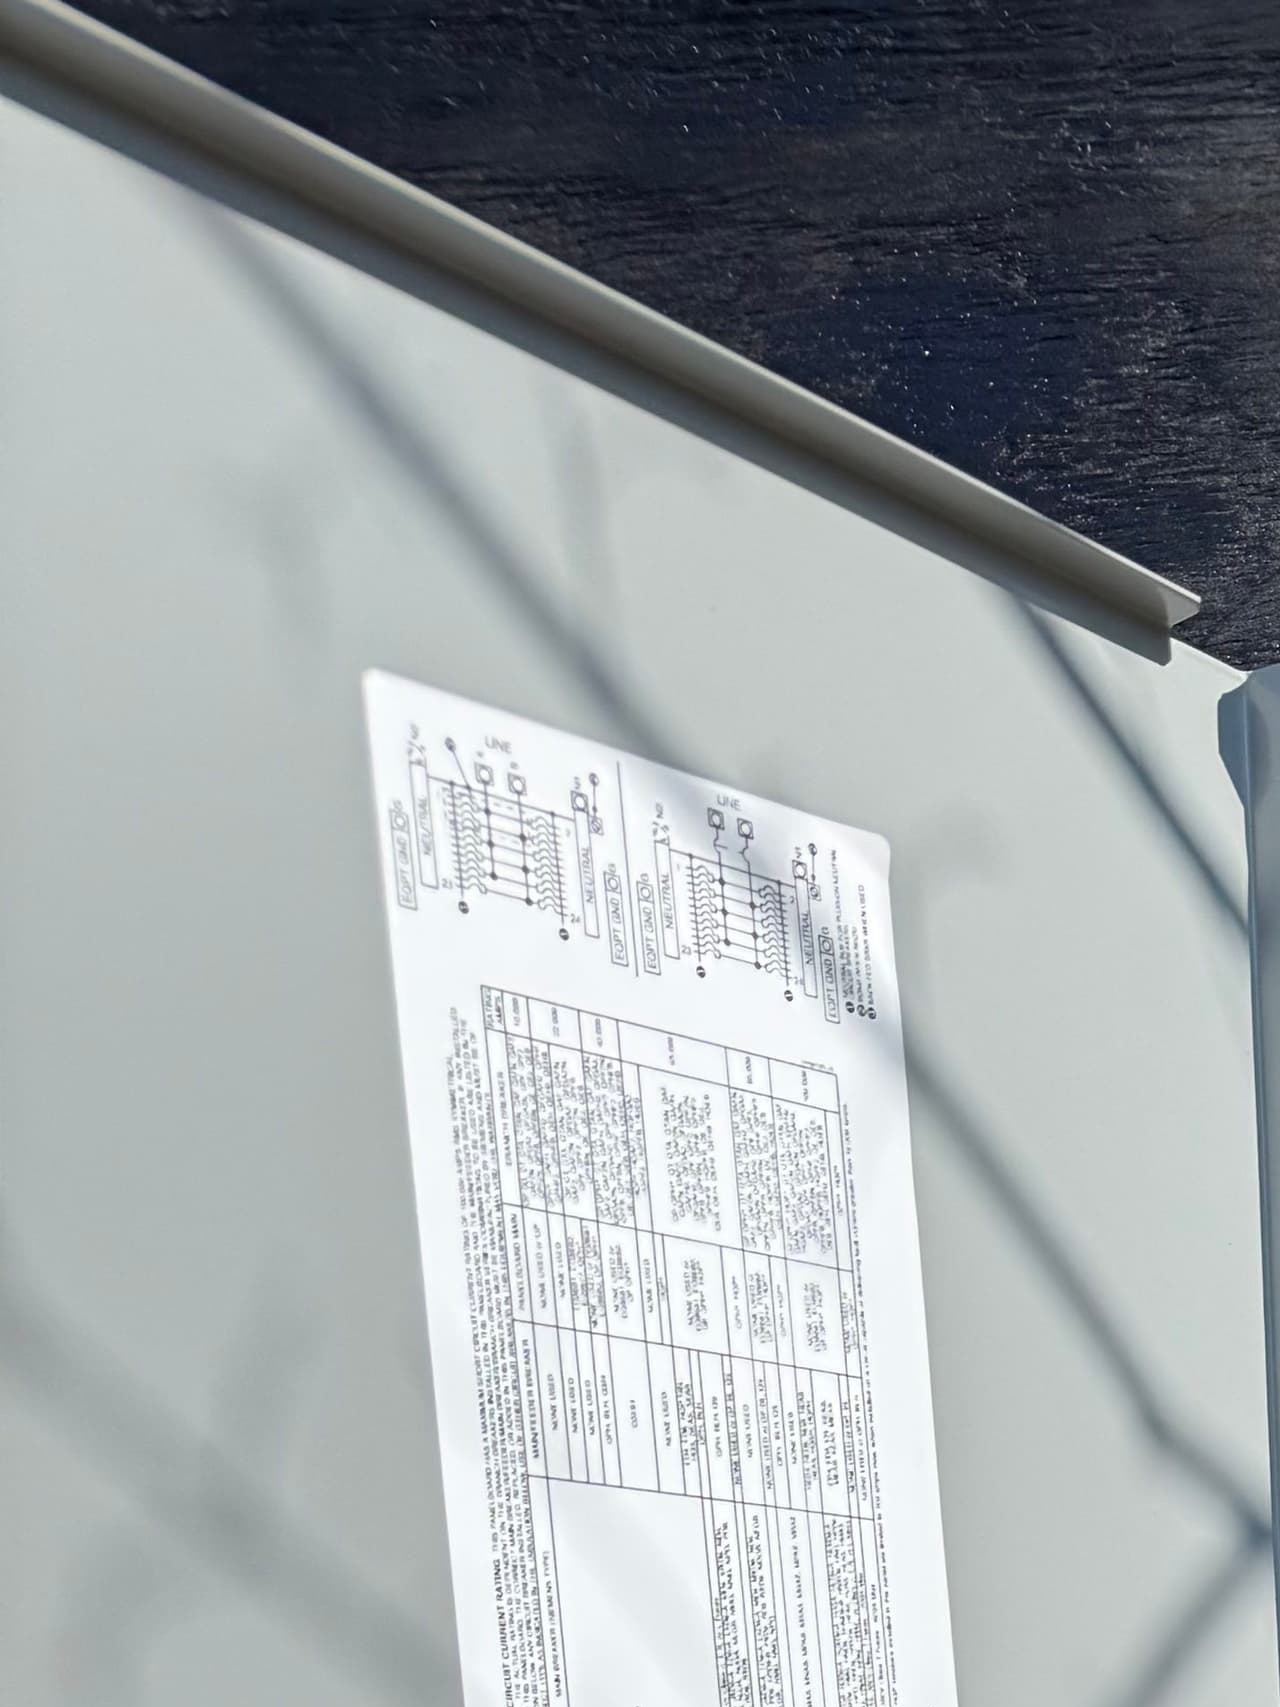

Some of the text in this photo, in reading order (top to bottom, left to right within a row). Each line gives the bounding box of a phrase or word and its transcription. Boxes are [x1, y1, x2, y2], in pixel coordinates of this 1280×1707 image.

[484, 734, 512, 754] LINE
[580, 844, 594, 904] NEUTRAL
[660, 871, 674, 930] NEUTRAL
[610, 896, 624, 961] EQPT GND
[642, 905, 657, 969] EQPT GND
[801, 909, 813, 966] NEUTRAL
[492, 1558, 503, 1601] RATING
[496, 1605, 509, 1659] CURRENT
[502, 1663, 514, 1707] CIRCUIT
